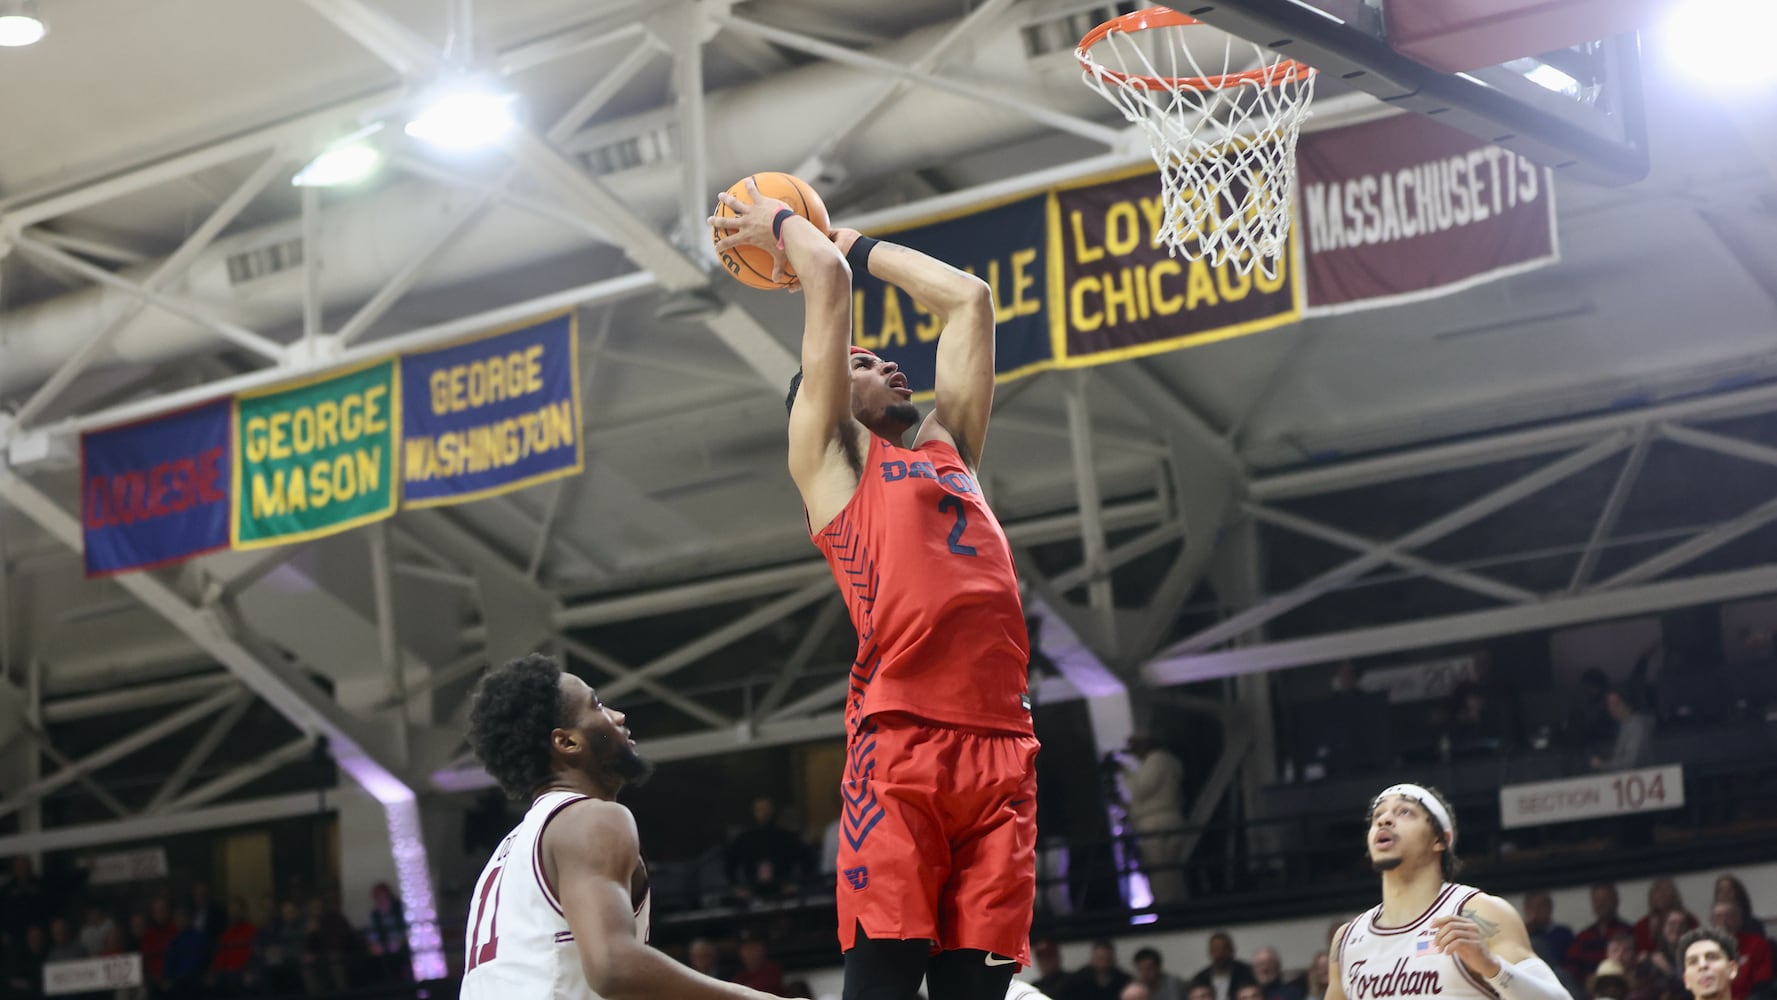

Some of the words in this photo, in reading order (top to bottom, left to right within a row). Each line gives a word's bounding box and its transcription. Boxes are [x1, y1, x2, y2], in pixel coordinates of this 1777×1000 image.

[1071, 170, 1278, 265] LOYOLA
[1306, 145, 1538, 254] MASSACHUSETTS
[853, 284, 908, 349] LA
[912, 248, 1041, 343] SLE
[1071, 247, 1286, 332] CHICAGO
[429, 343, 544, 415] GEORGE
[246, 383, 388, 463] GEORGE
[405, 397, 574, 482] WASHINGTON
[252, 445, 382, 520] MASON
[938, 494, 977, 557] 2
[1612, 773, 1665, 810] 104
[1349, 956, 1442, 1000] Fordham
